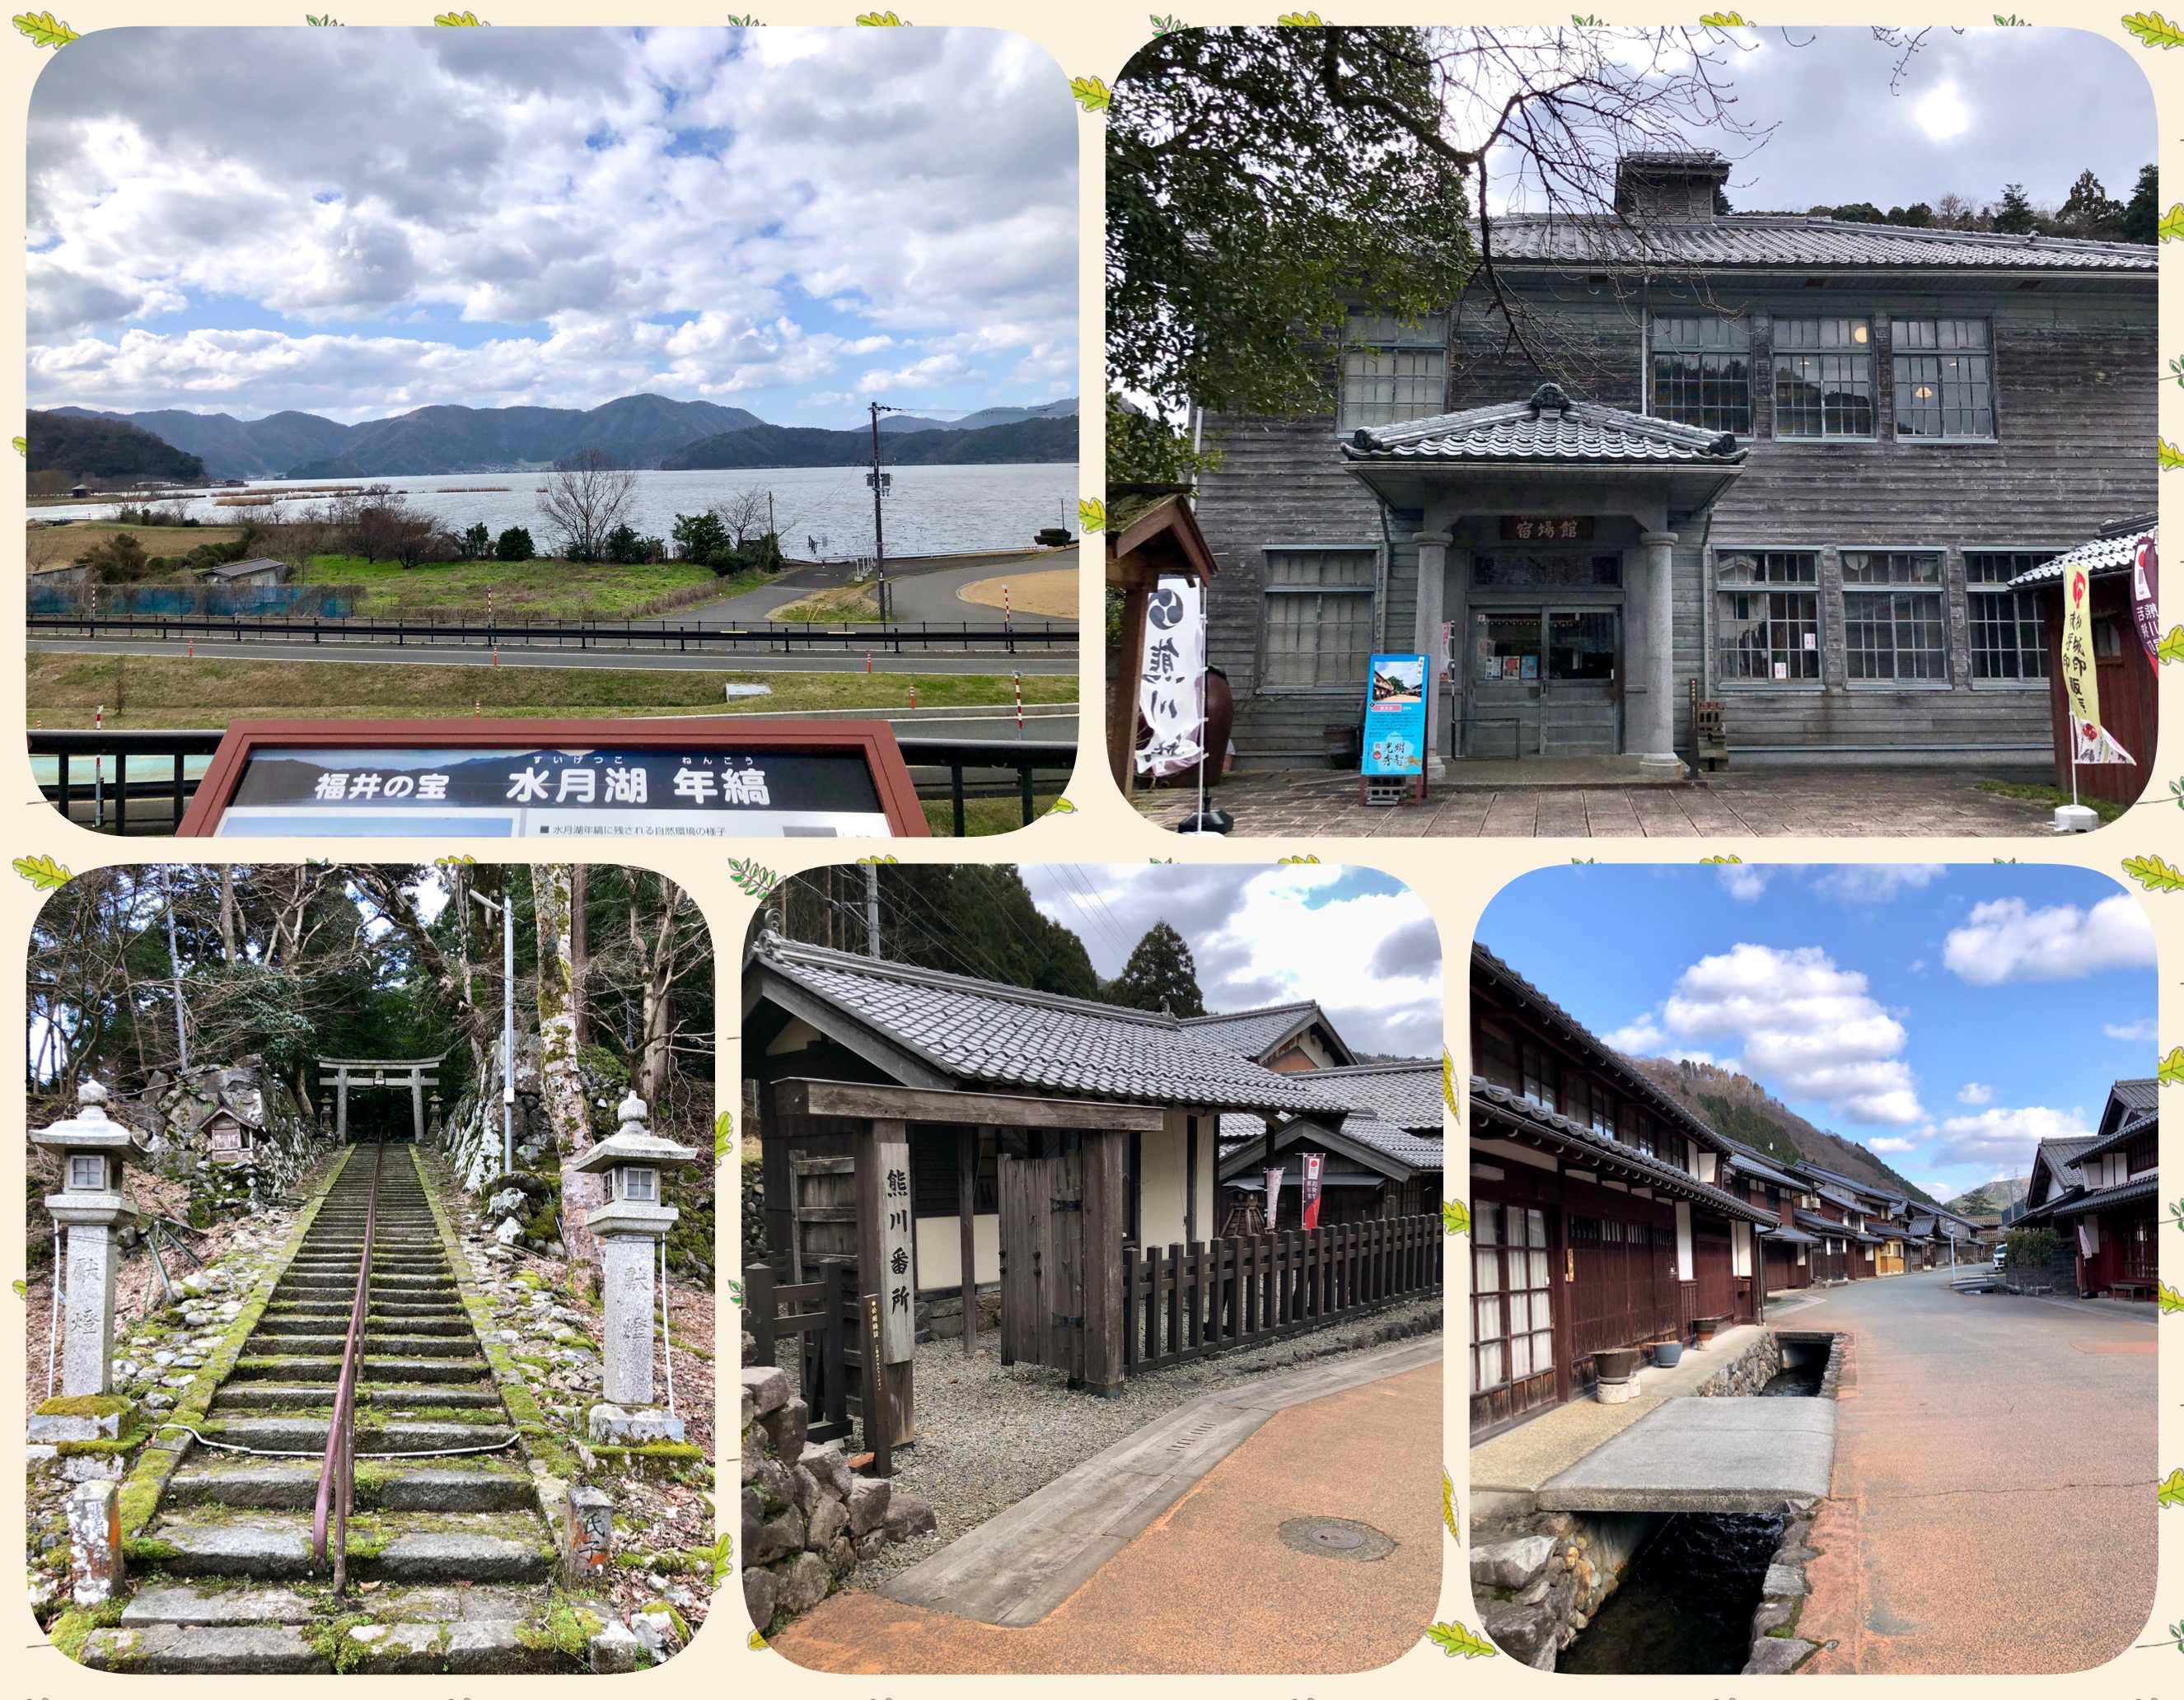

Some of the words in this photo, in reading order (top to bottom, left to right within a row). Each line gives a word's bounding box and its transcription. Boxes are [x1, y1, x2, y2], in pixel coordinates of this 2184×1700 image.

[1517, 521, 1578, 539] 宿場館
[681, 756, 754, 765] ねんこう
[315, 773, 450, 800] 福井の宝
[506, 767, 648, 804] 水月湖
[673, 768, 770, 805] 年縞
[553, 825, 727, 837] 水月湖年縞に残される自然環境の様子
[886, 1169, 910, 1315] 熊川番所
